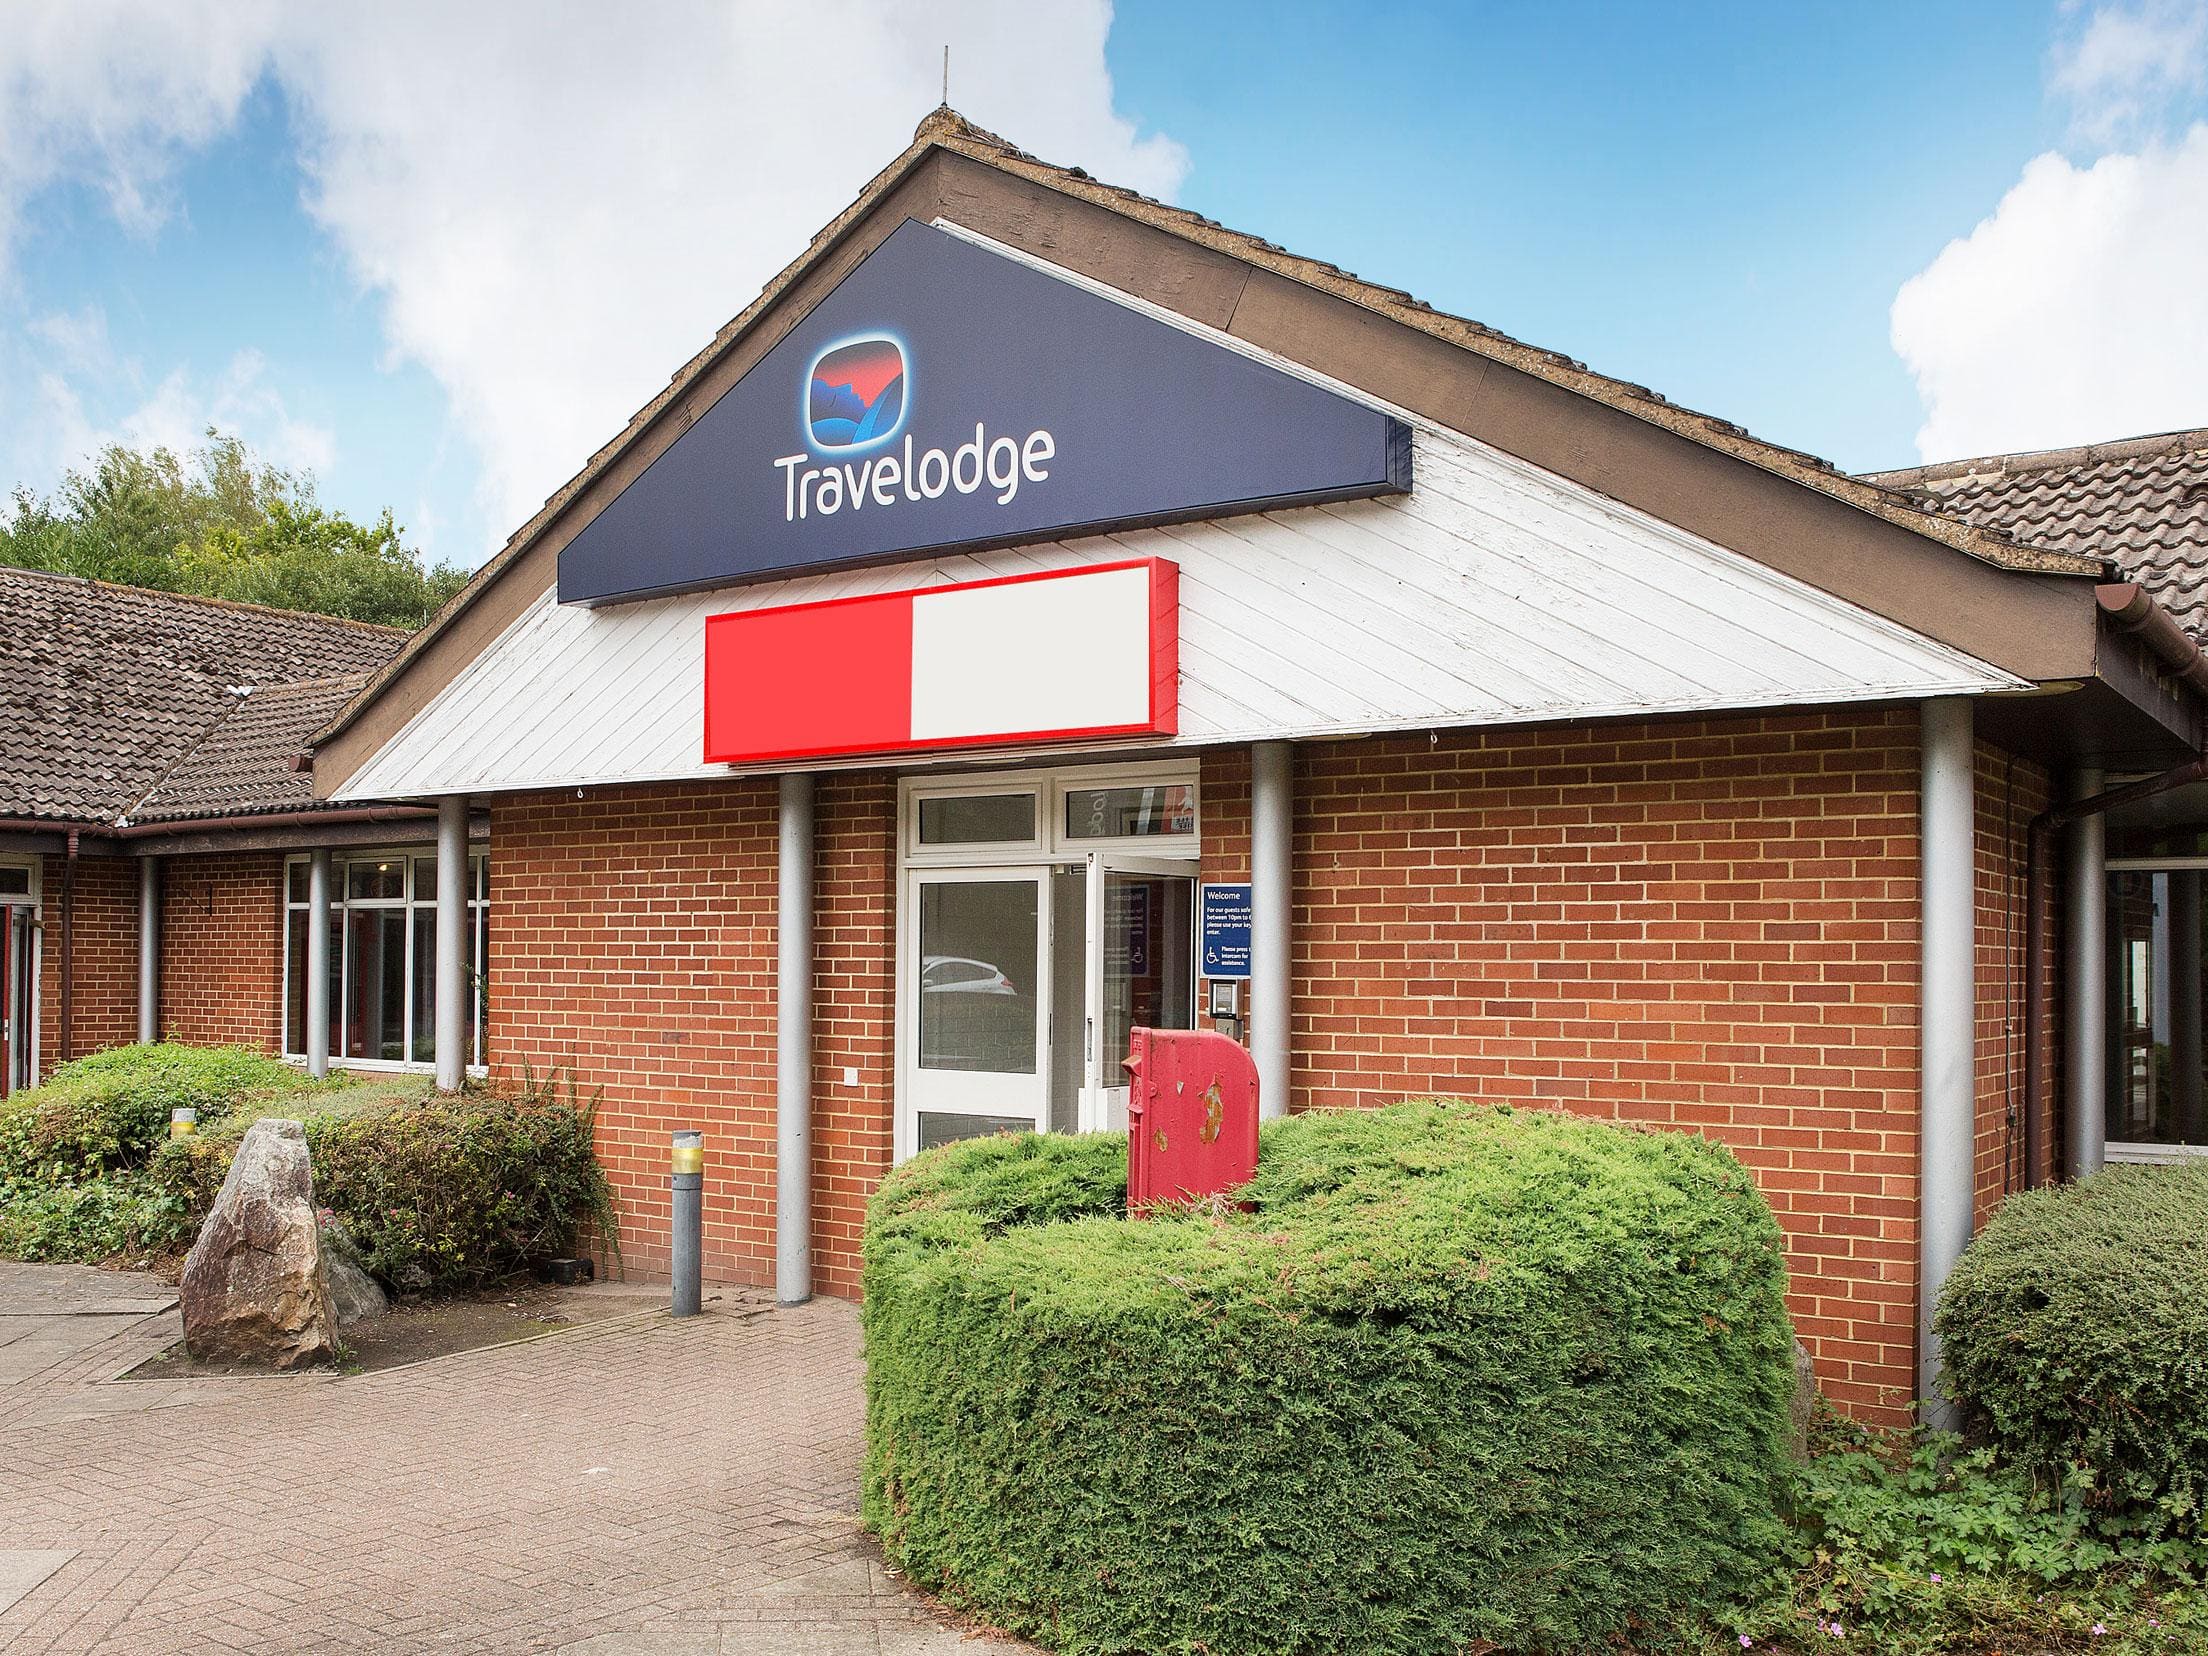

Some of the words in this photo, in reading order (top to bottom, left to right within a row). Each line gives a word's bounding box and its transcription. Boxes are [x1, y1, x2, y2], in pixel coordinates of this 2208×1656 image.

[773, 422, 1056, 521] Travelodge
[1207, 891, 1241, 900] Welcome
[1228, 914, 1242, 922] 10pm
